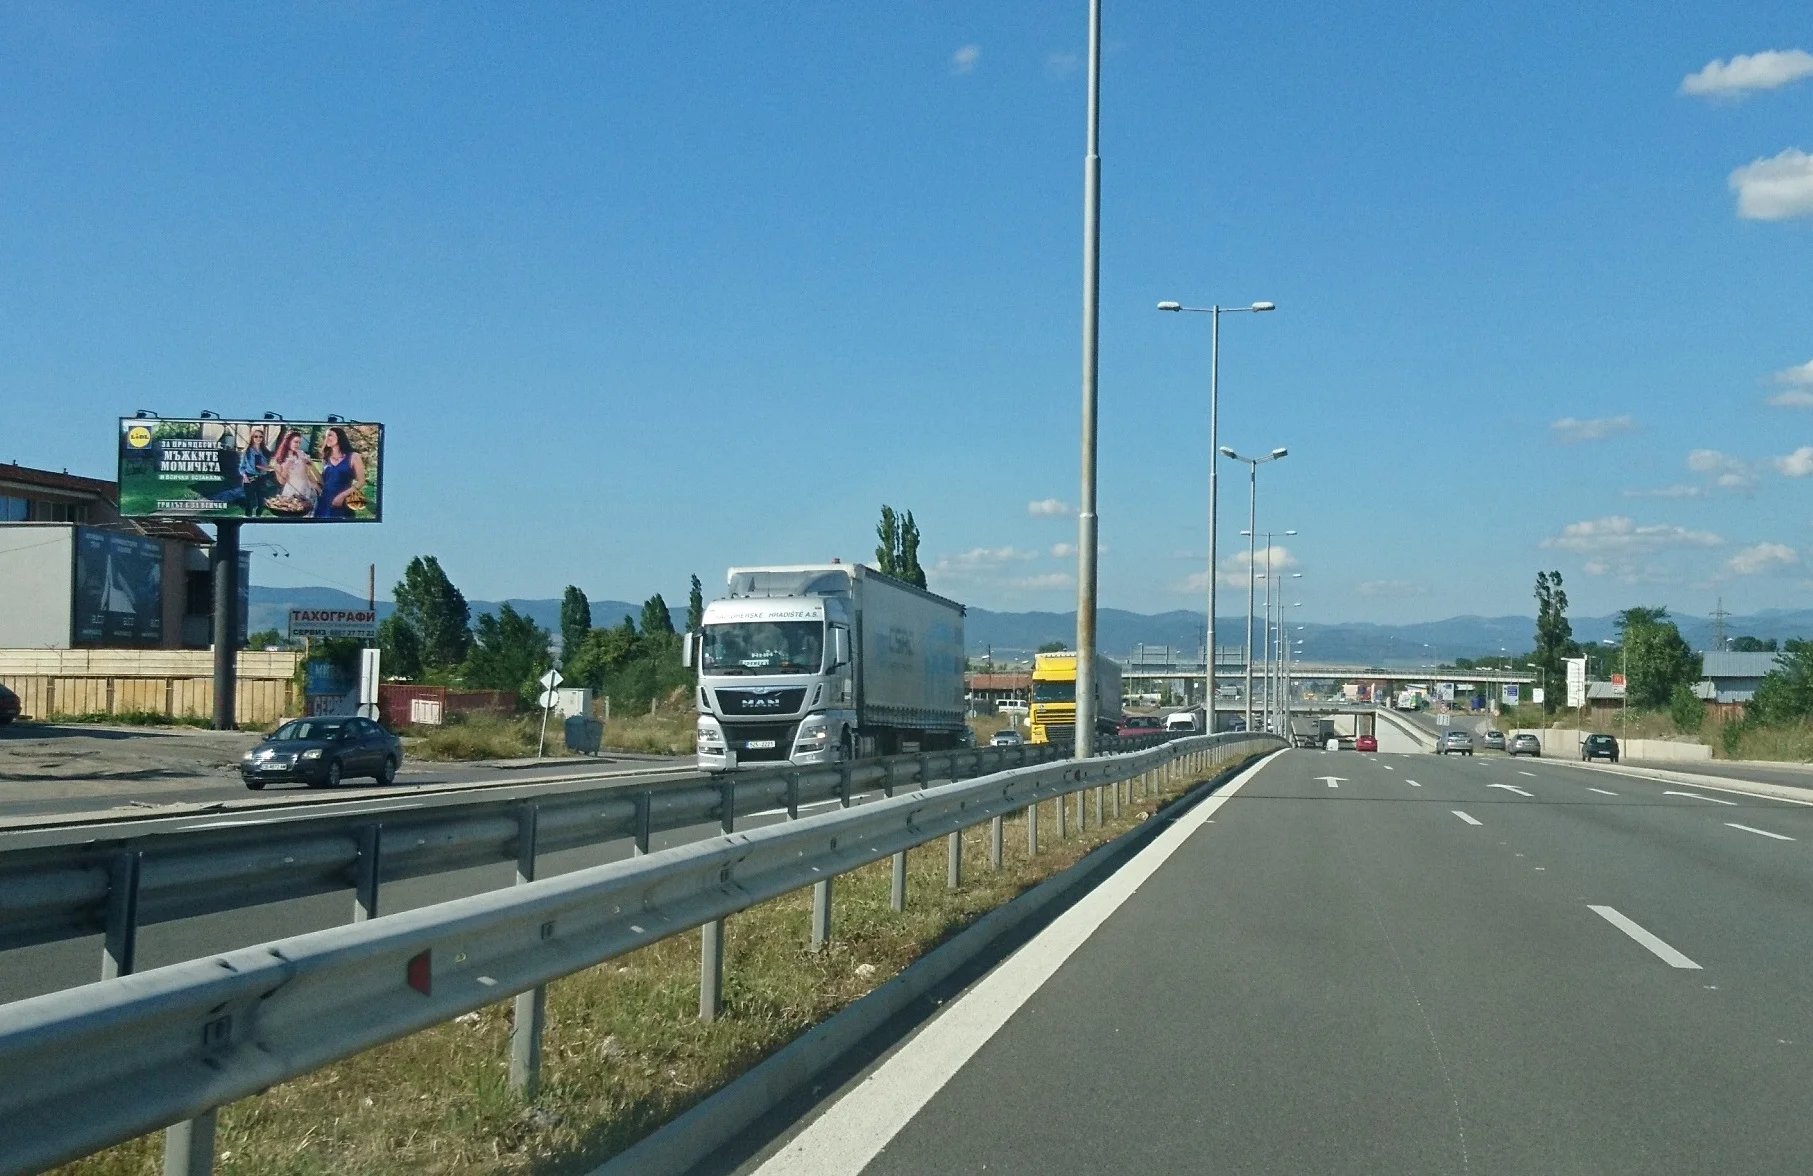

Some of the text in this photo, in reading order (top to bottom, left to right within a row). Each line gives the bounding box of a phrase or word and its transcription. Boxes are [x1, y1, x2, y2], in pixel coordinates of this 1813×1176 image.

[161, 440, 171, 448] ЗА
[164, 450, 219, 461] МЪЖКИТЕ
[160, 461, 221, 472] МОМИЧЕТА
[293, 610, 375, 622] ТАХОГРАФИ
[742, 699, 779, 708] MAN
